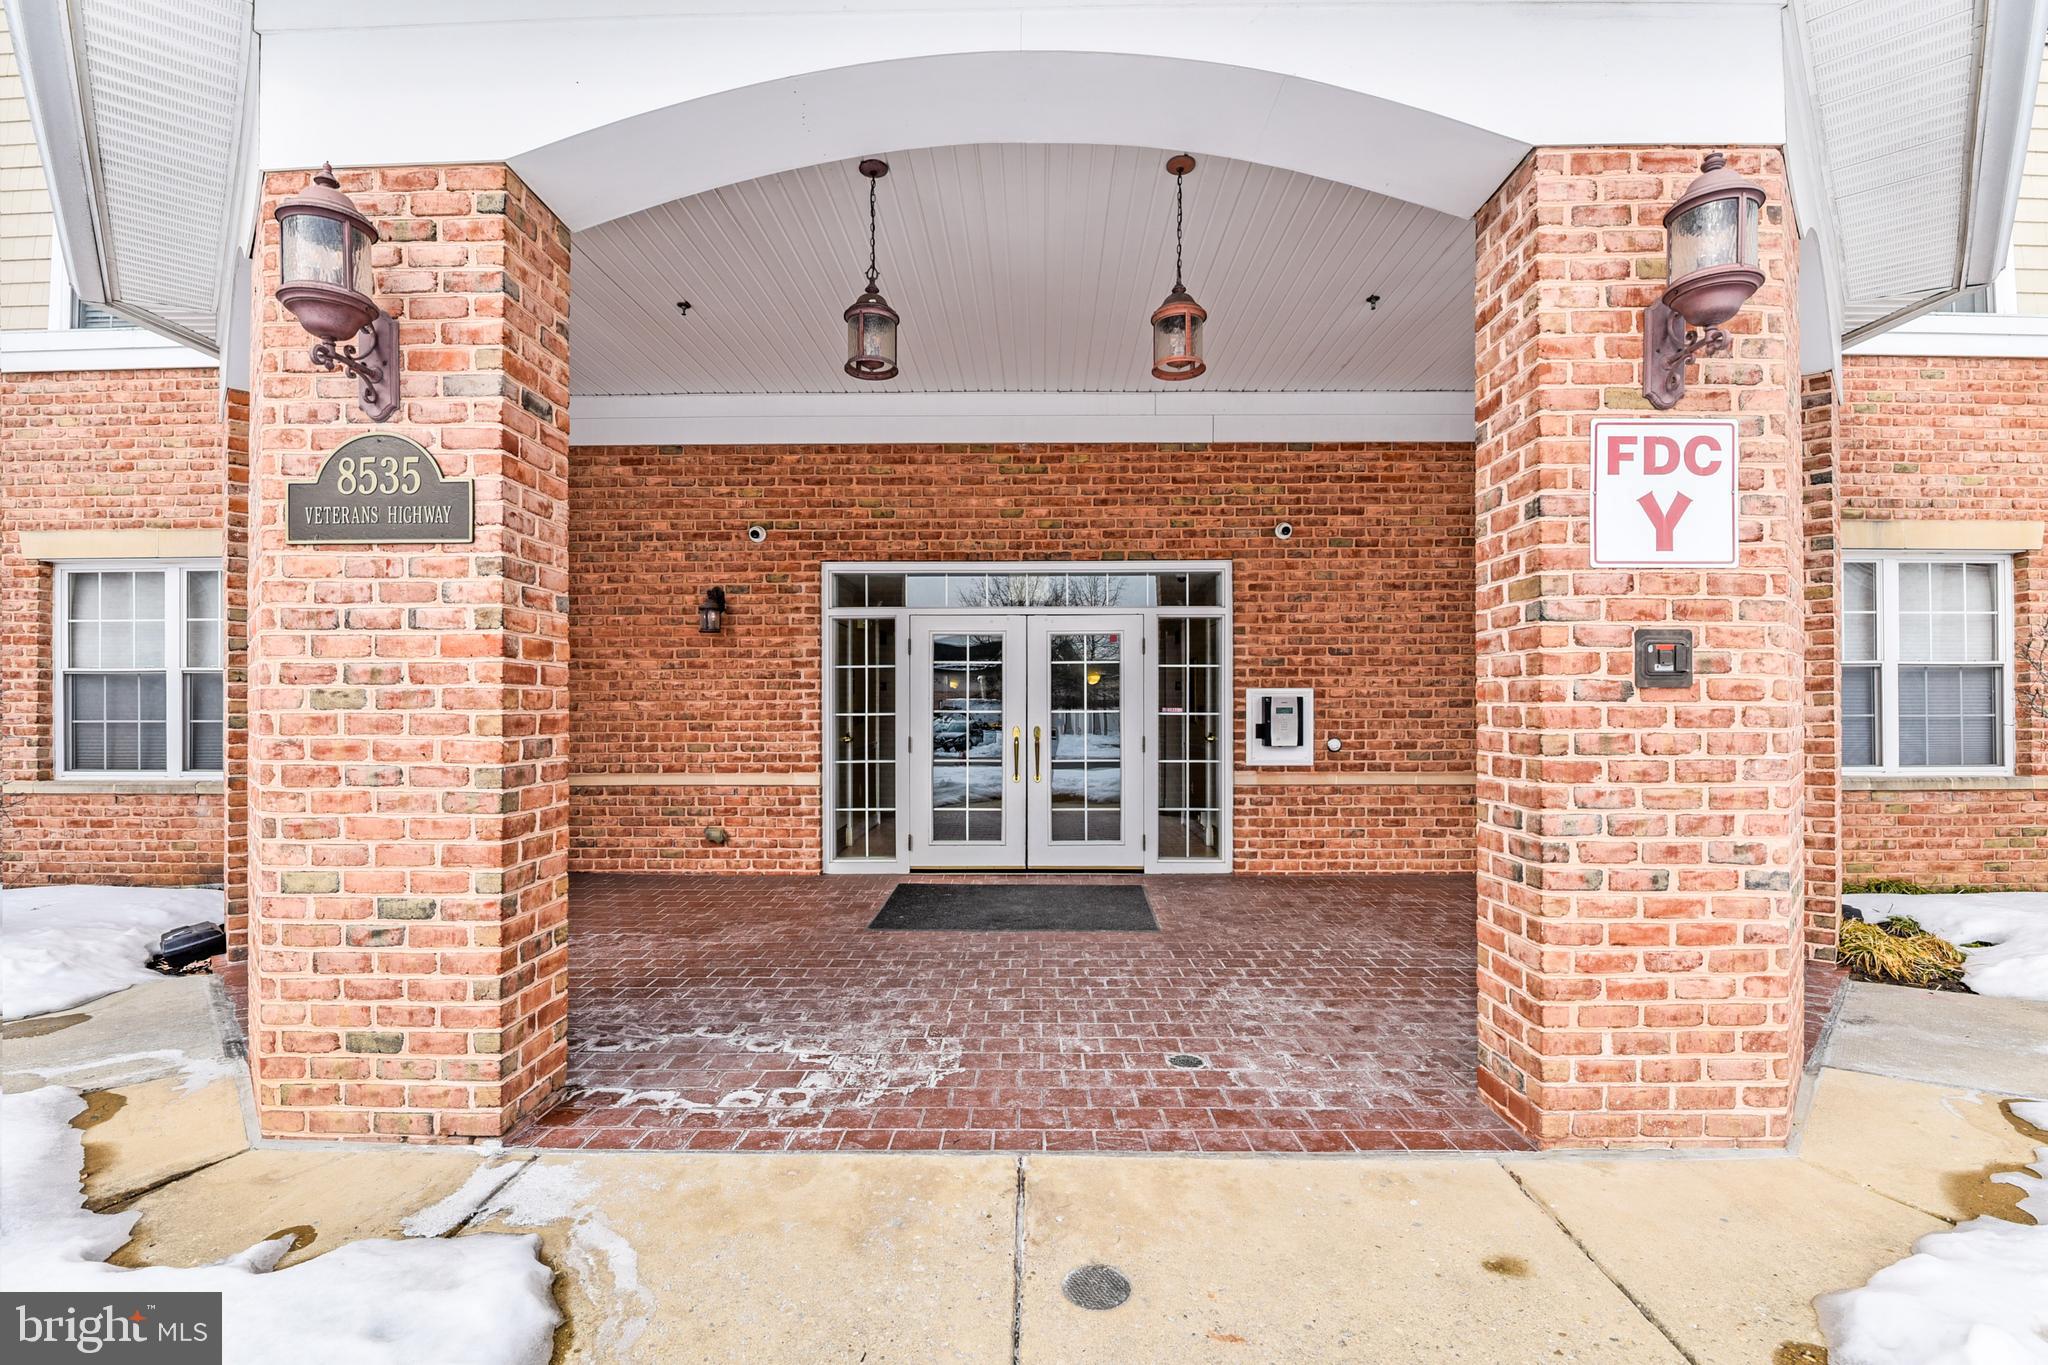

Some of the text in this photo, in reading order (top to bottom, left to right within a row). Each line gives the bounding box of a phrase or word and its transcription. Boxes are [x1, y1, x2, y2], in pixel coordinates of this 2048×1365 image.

[336, 456, 422, 495] 8535
[1607, 435, 1723, 477] FDC
[305, 505, 452, 525] VETERANS HIGHWAY
